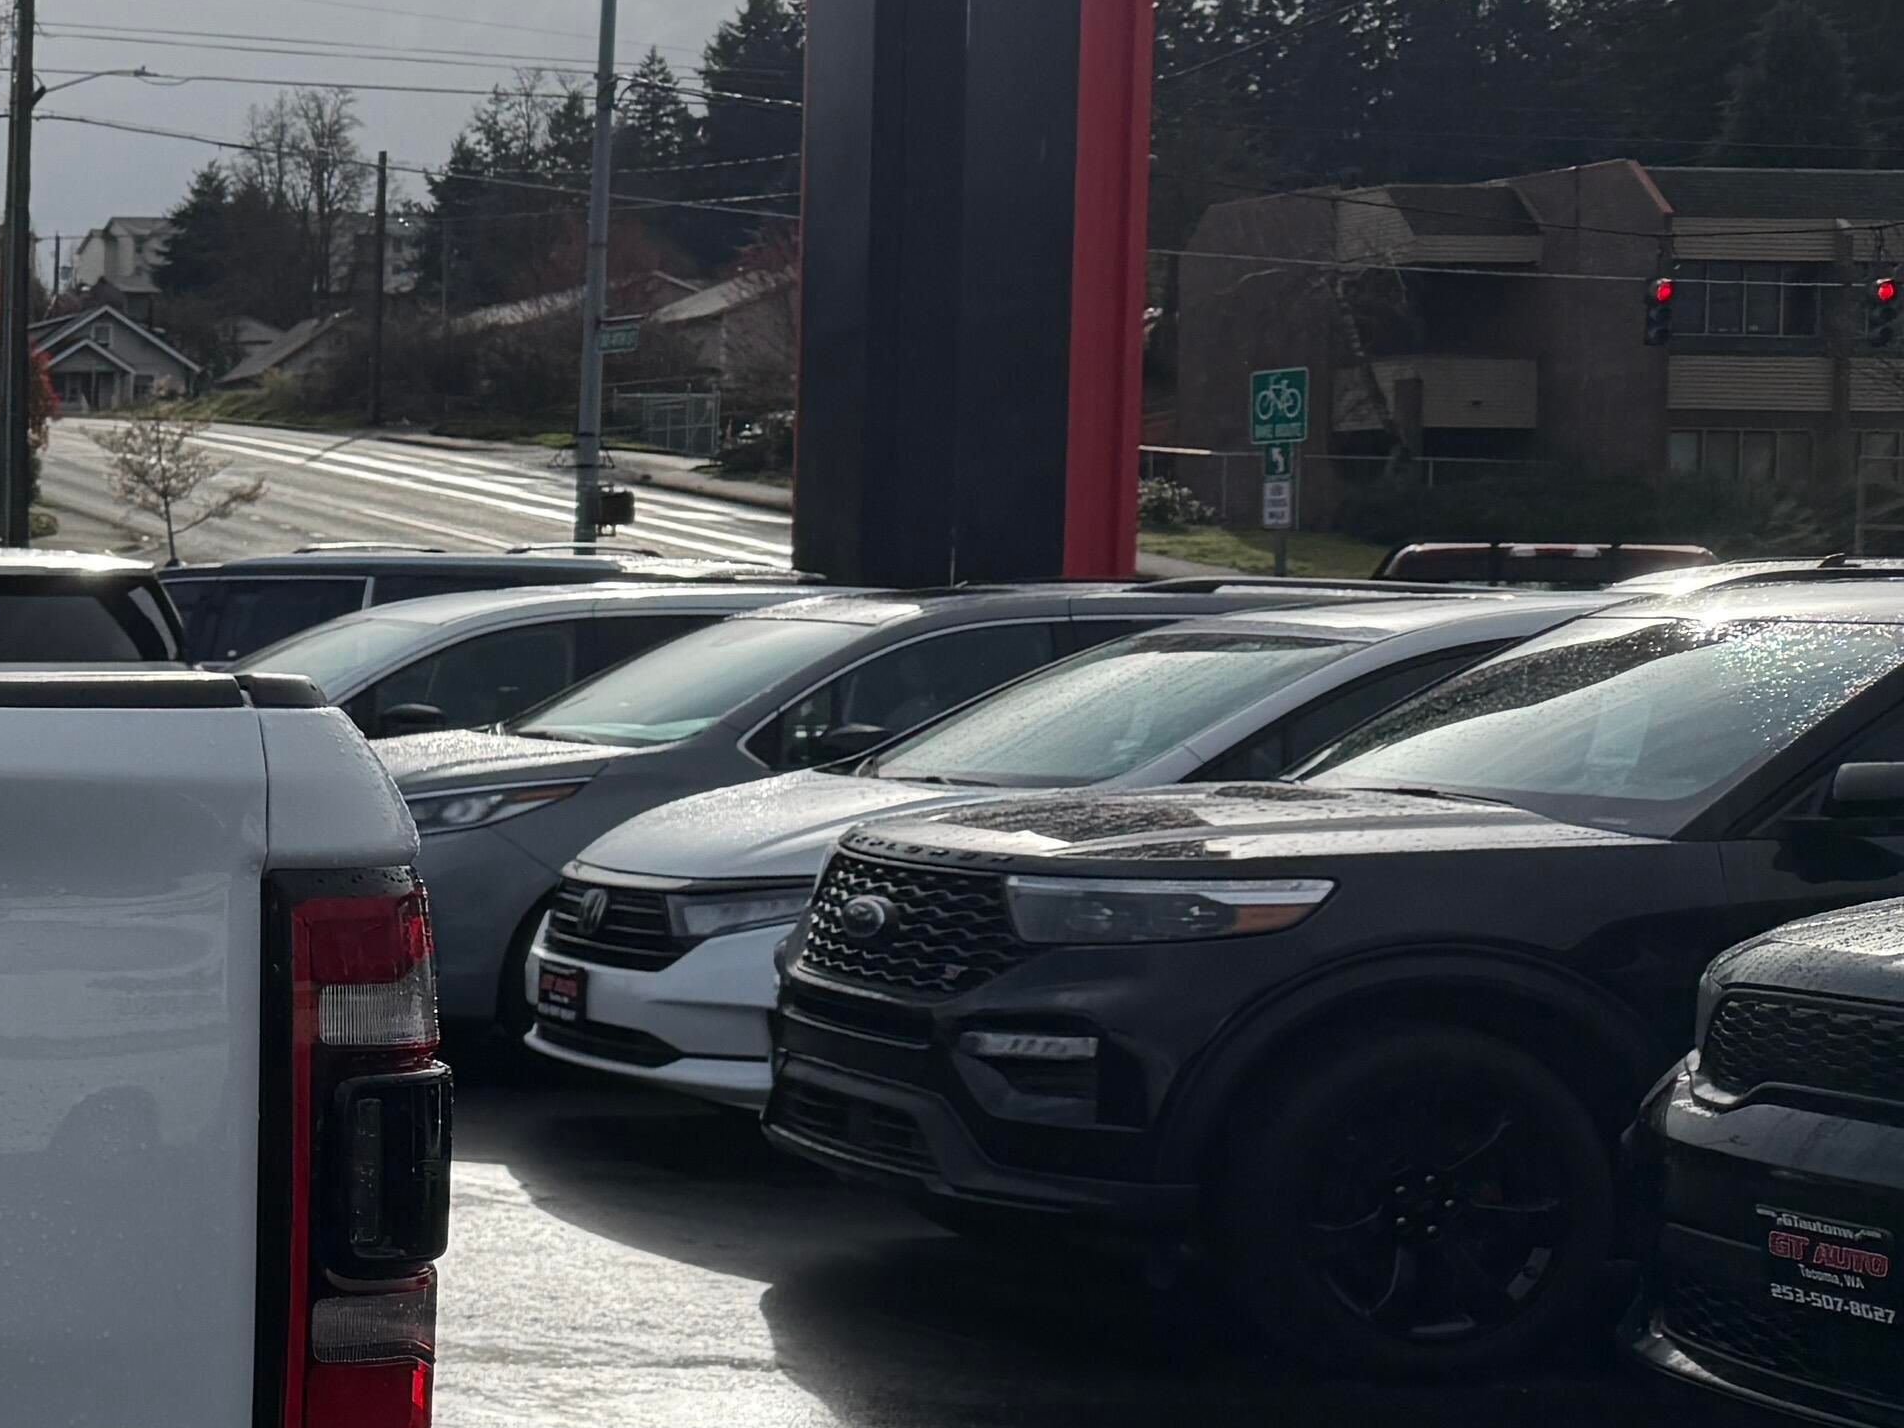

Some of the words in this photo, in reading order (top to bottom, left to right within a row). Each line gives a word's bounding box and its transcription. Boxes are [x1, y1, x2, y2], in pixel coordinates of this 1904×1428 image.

[1768, 1230, 1809, 1260] GT
[1813, 1242, 1889, 1277] AUTO
[1770, 1283, 1896, 1324] 253-507-8027
